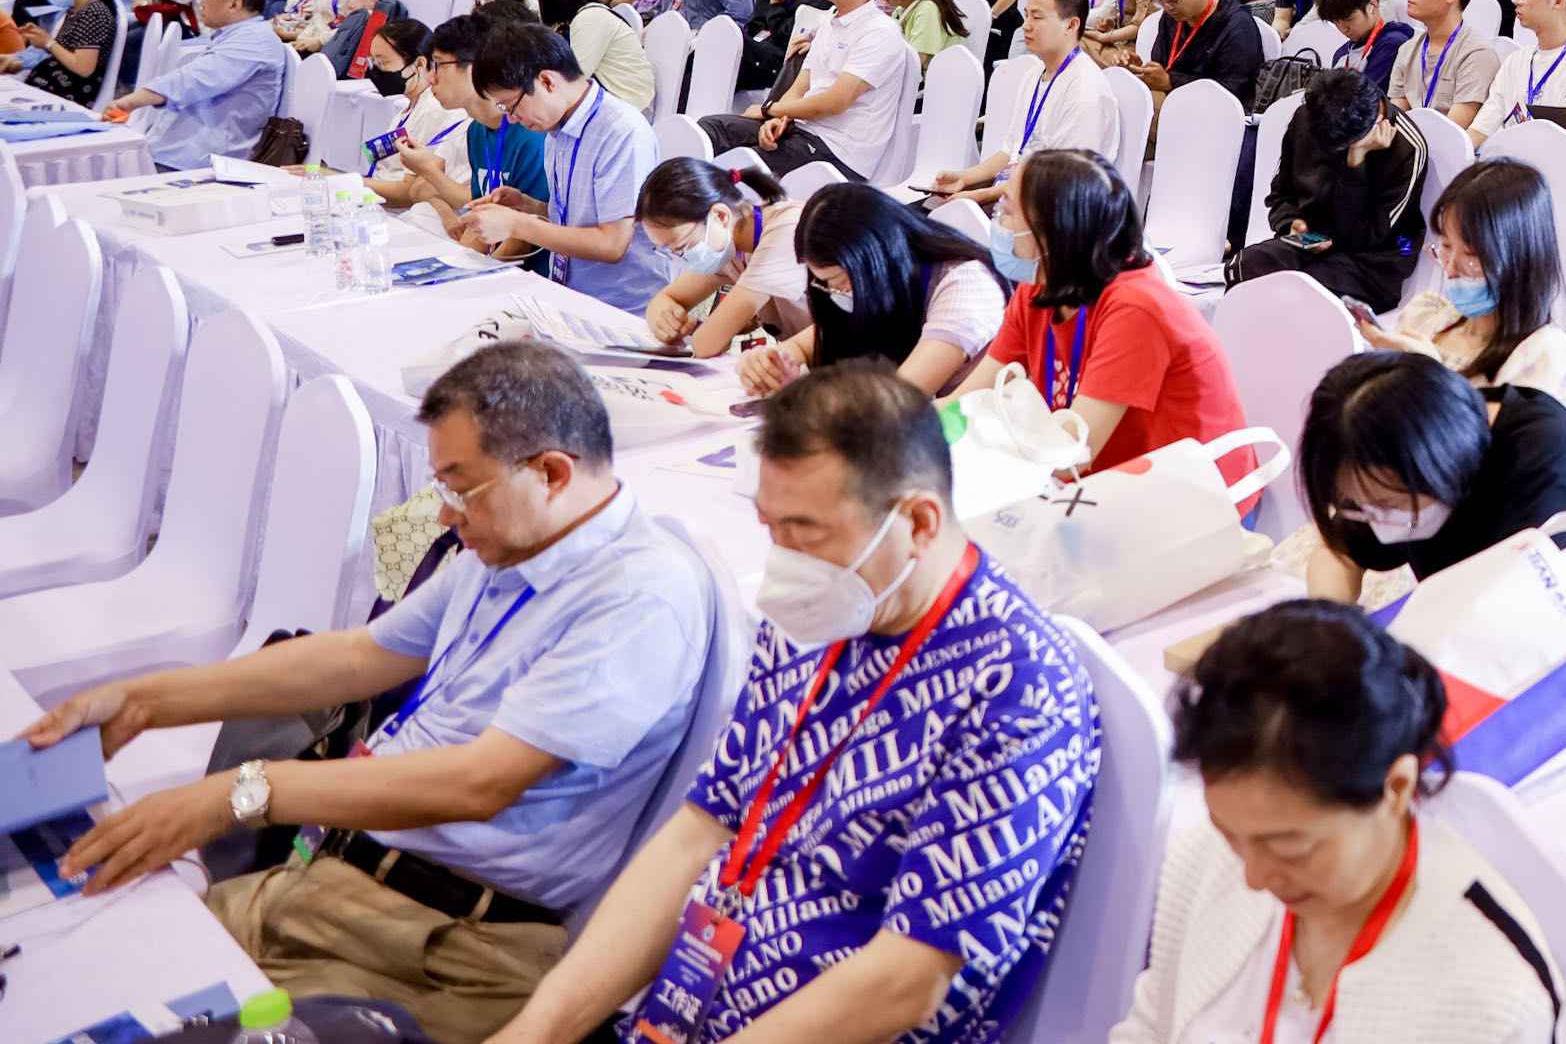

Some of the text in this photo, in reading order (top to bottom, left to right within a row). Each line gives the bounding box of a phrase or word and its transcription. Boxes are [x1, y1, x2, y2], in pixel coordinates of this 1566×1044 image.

[839, 774, 913, 818] Milano
[942, 733, 1083, 829] Milano
[748, 889, 860, 944] Milano
[921, 859, 1040, 929] Milano
